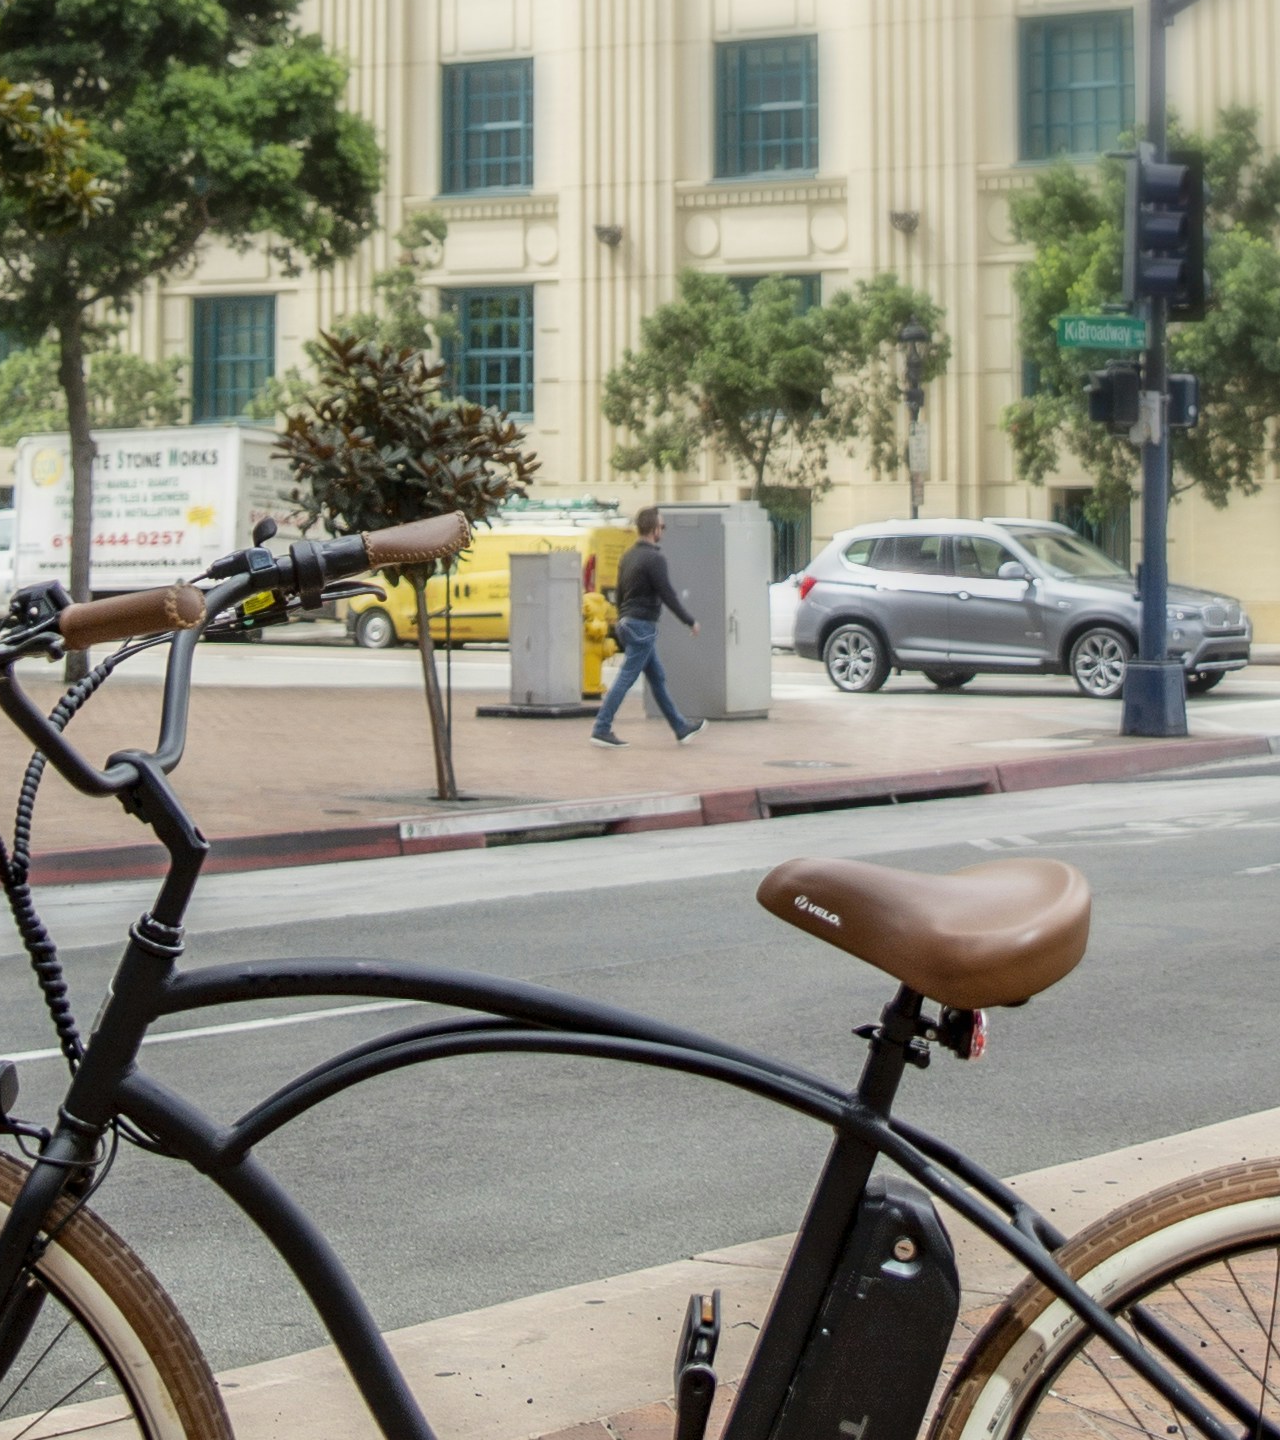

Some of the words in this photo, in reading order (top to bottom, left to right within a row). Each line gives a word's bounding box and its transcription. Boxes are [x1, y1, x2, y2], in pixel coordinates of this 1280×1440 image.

[52, 531, 185, 548] 61-444-0257
[808, 903, 839, 923] VELO
[1022, 1343, 1046, 1374] FAT
